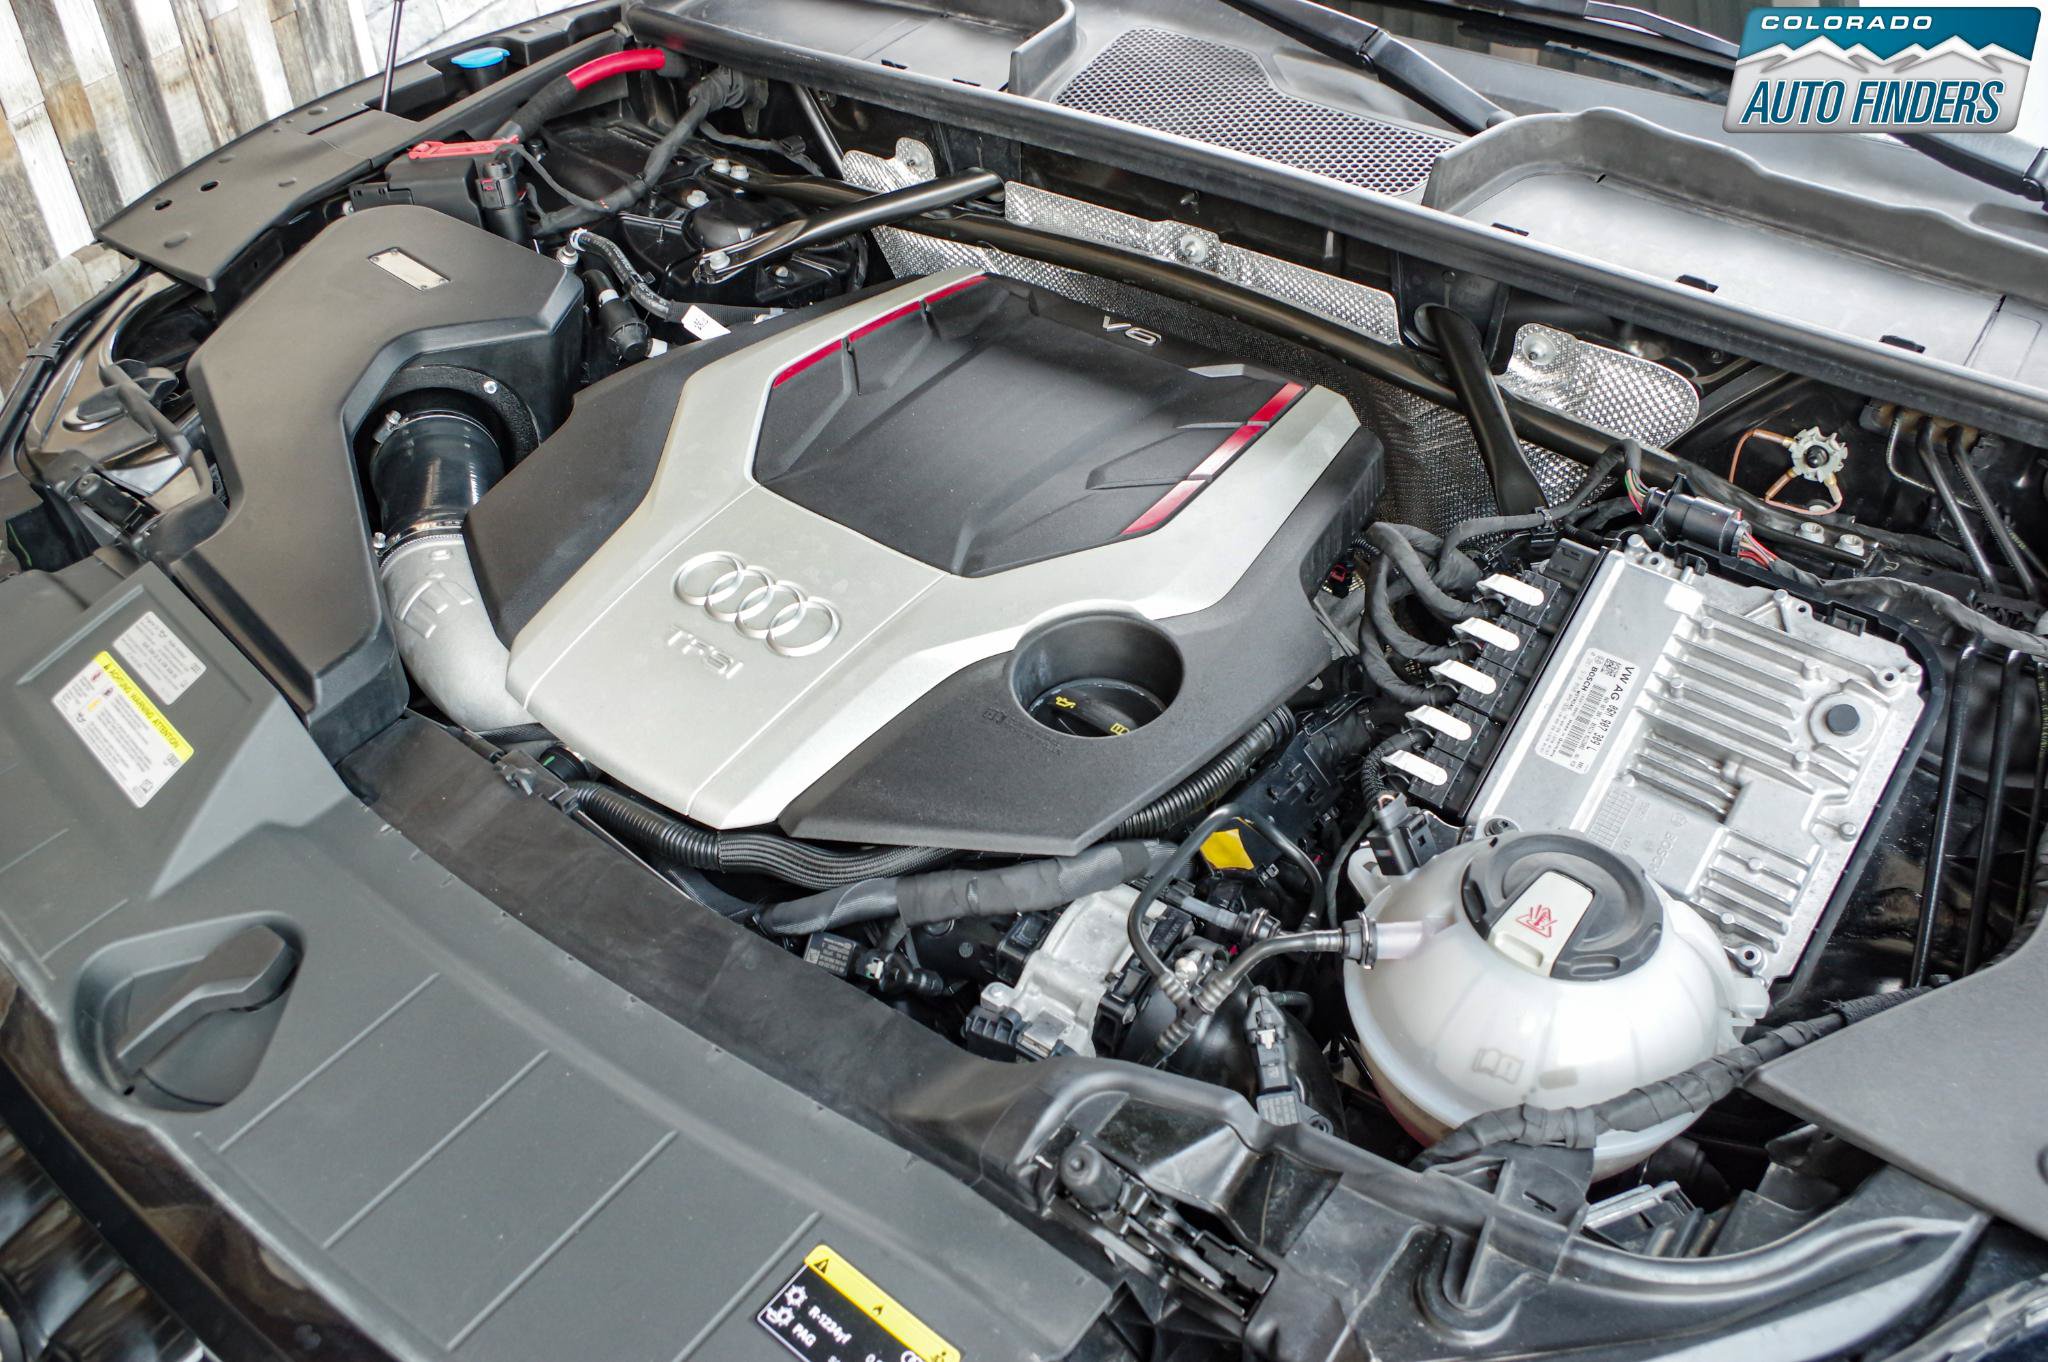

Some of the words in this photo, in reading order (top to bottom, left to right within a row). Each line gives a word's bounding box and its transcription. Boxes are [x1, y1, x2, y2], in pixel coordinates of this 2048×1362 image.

[1103, 315, 1161, 347] V6
[1582, 666, 1598, 692] BOSCH
[1620, 666, 1635, 684] VW
[1610, 684, 1623, 700] AG
[131, 692, 154, 719] WARNING
[151, 717, 181, 749] ATTENTION
[1652, 832, 1680, 876] BOSCH
[791, 1322, 817, 1348] PAG
